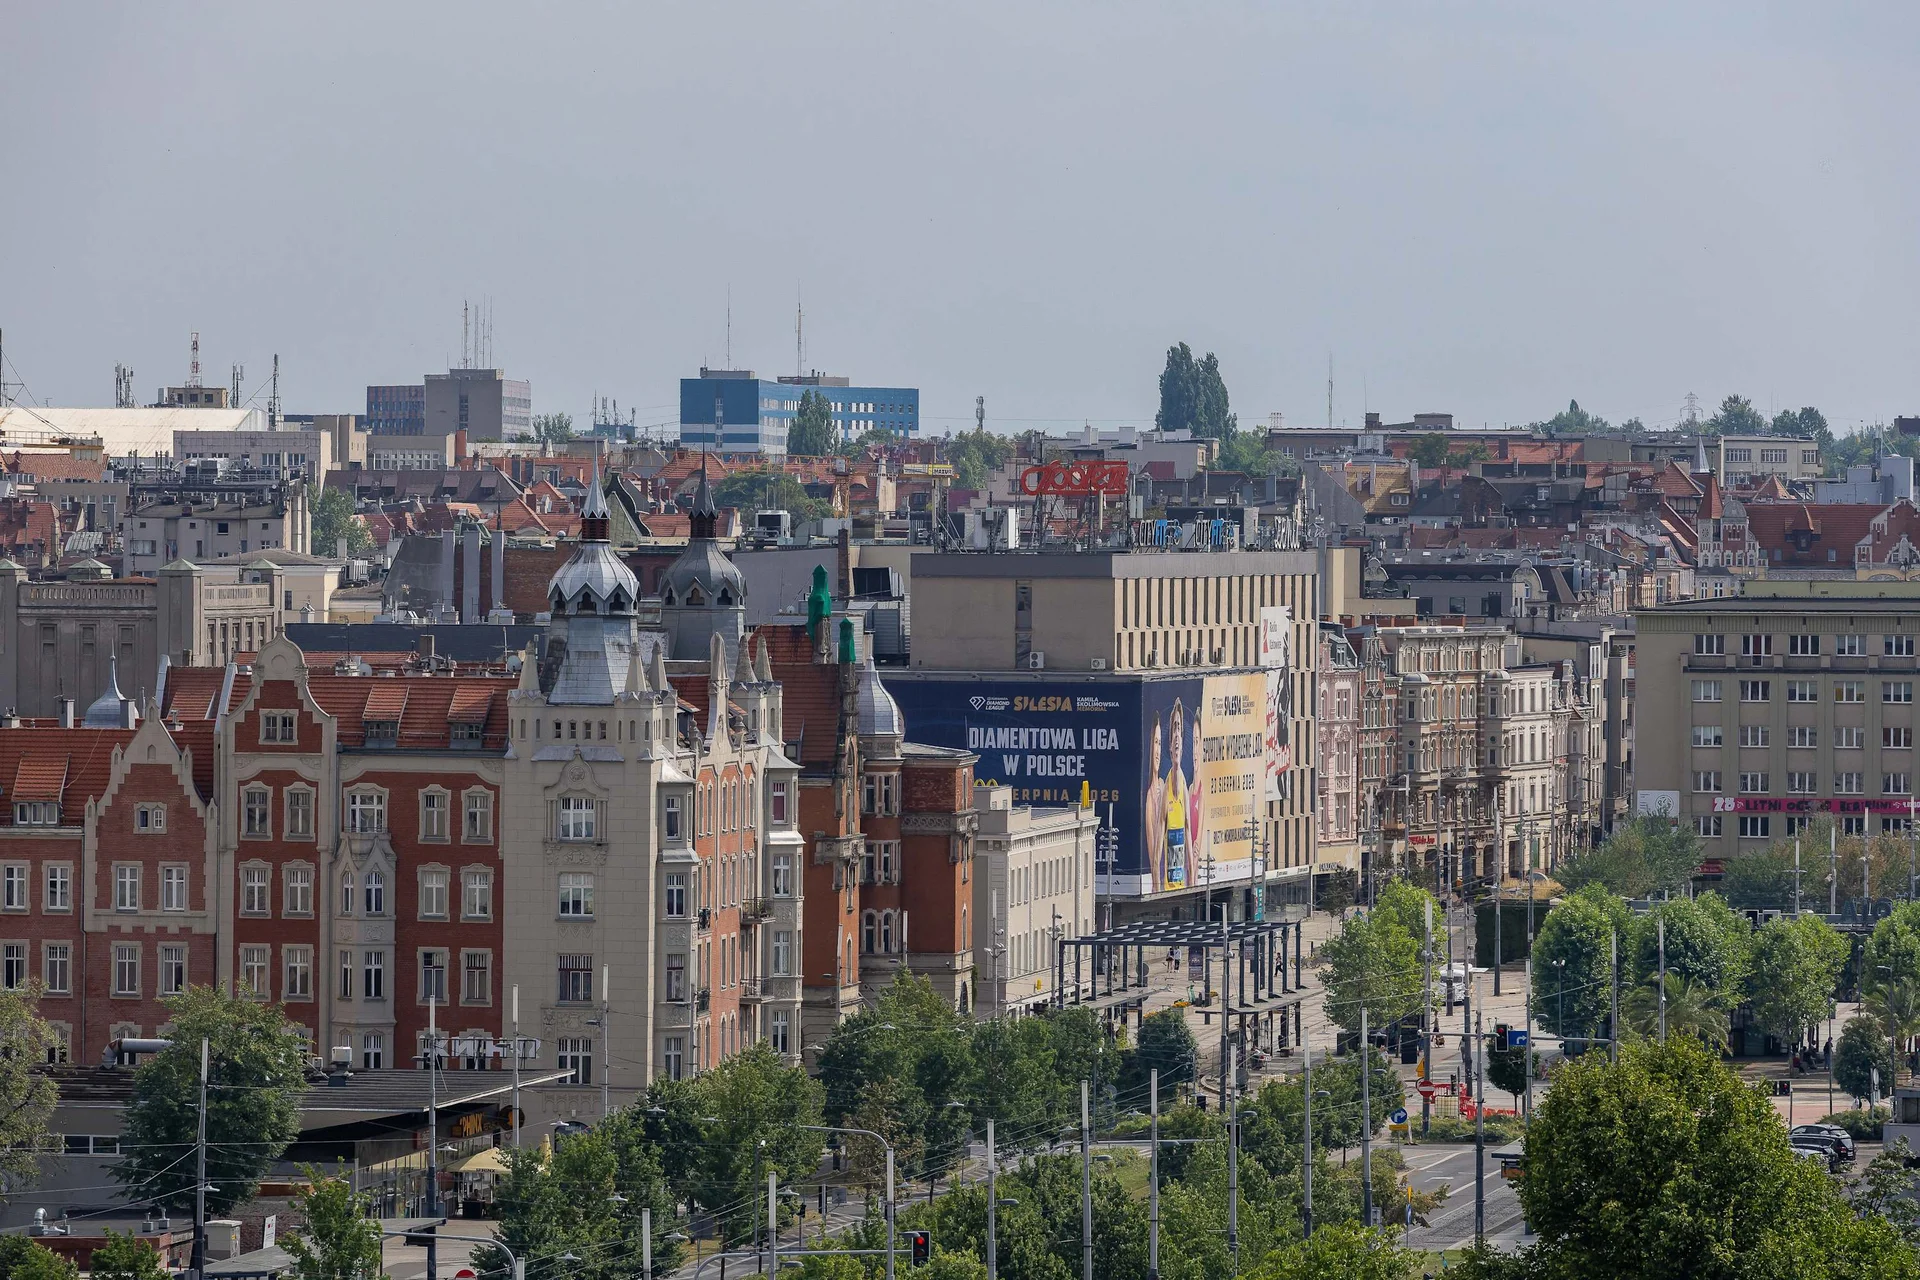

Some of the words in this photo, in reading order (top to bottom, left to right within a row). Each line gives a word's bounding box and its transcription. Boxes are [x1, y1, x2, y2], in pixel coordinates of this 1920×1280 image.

[1013, 696, 1073, 712] SILESIA
[968, 727, 1076, 751] DIAMENTOWA
[1083, 728, 1119, 751] LIGA
[1003, 756, 1020, 776] W
[1026, 755, 1086, 777] POLSCE
[1012, 788, 1069, 801] ERPNIA
